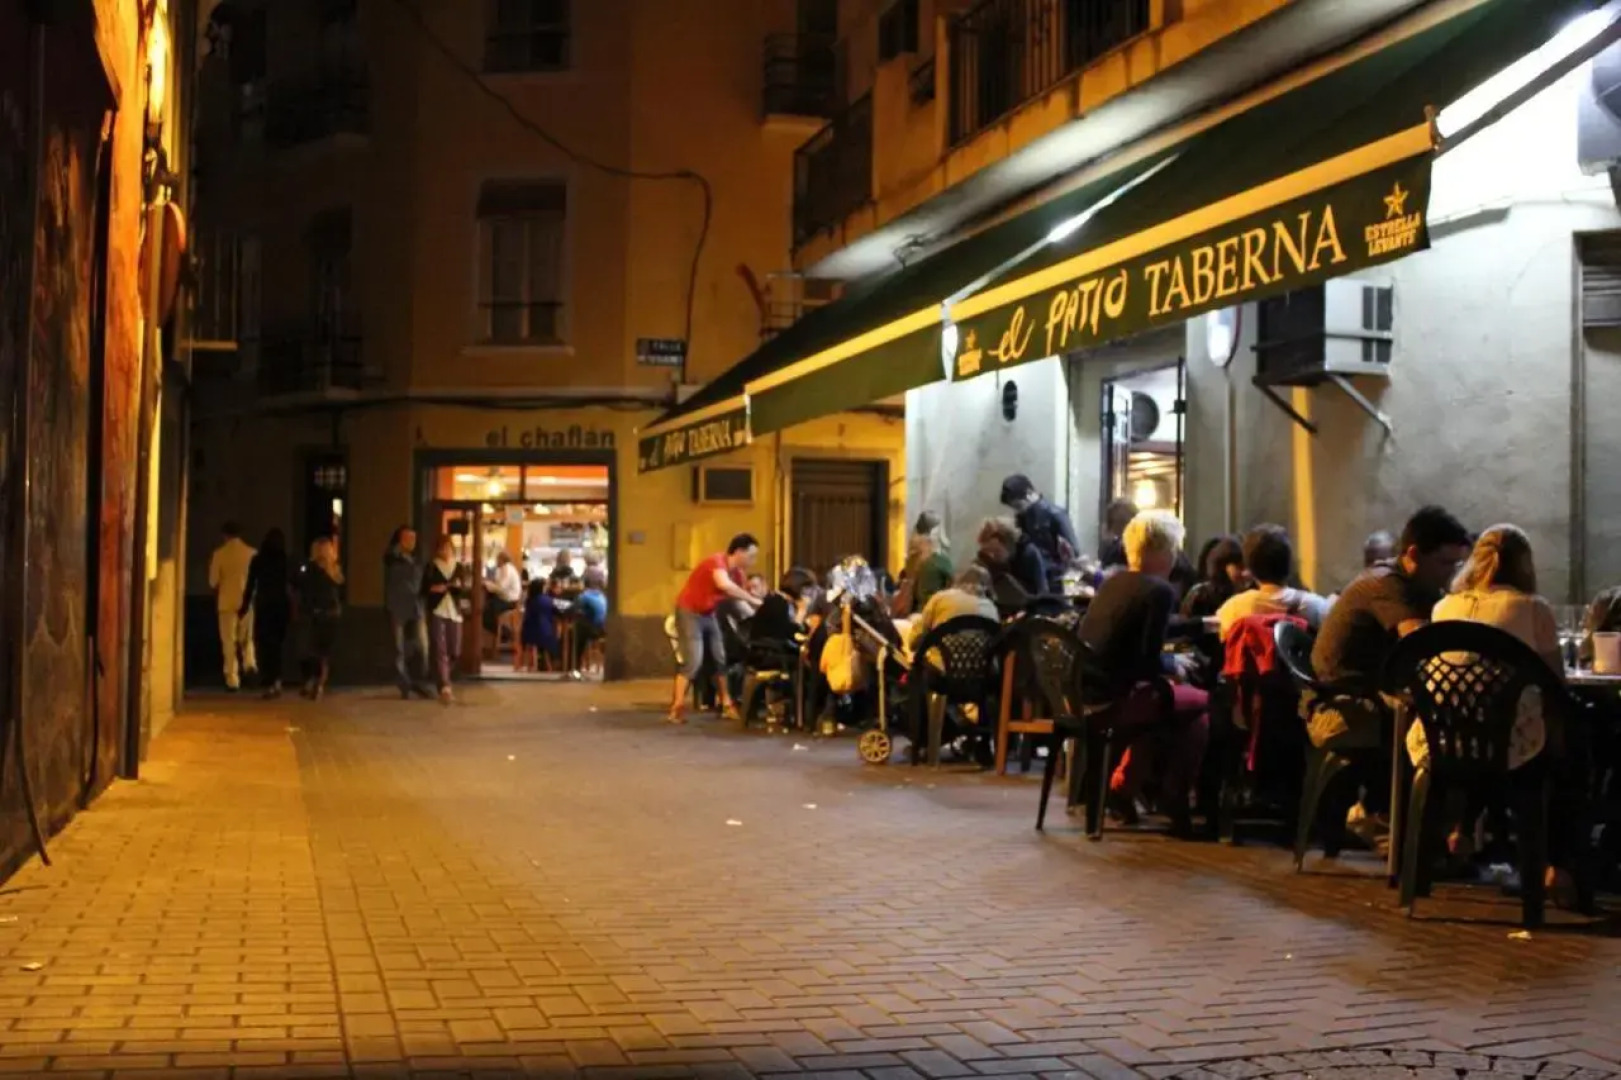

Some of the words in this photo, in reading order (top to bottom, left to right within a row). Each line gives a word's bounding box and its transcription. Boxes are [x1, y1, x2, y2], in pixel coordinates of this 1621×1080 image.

[1365, 210, 1421, 243] ESTRELLA
[987, 305, 1035, 363] el
[1045, 268, 1128, 356] PATIO
[1144, 204, 1347, 317] TABERNA
[485, 425, 508, 447] el
